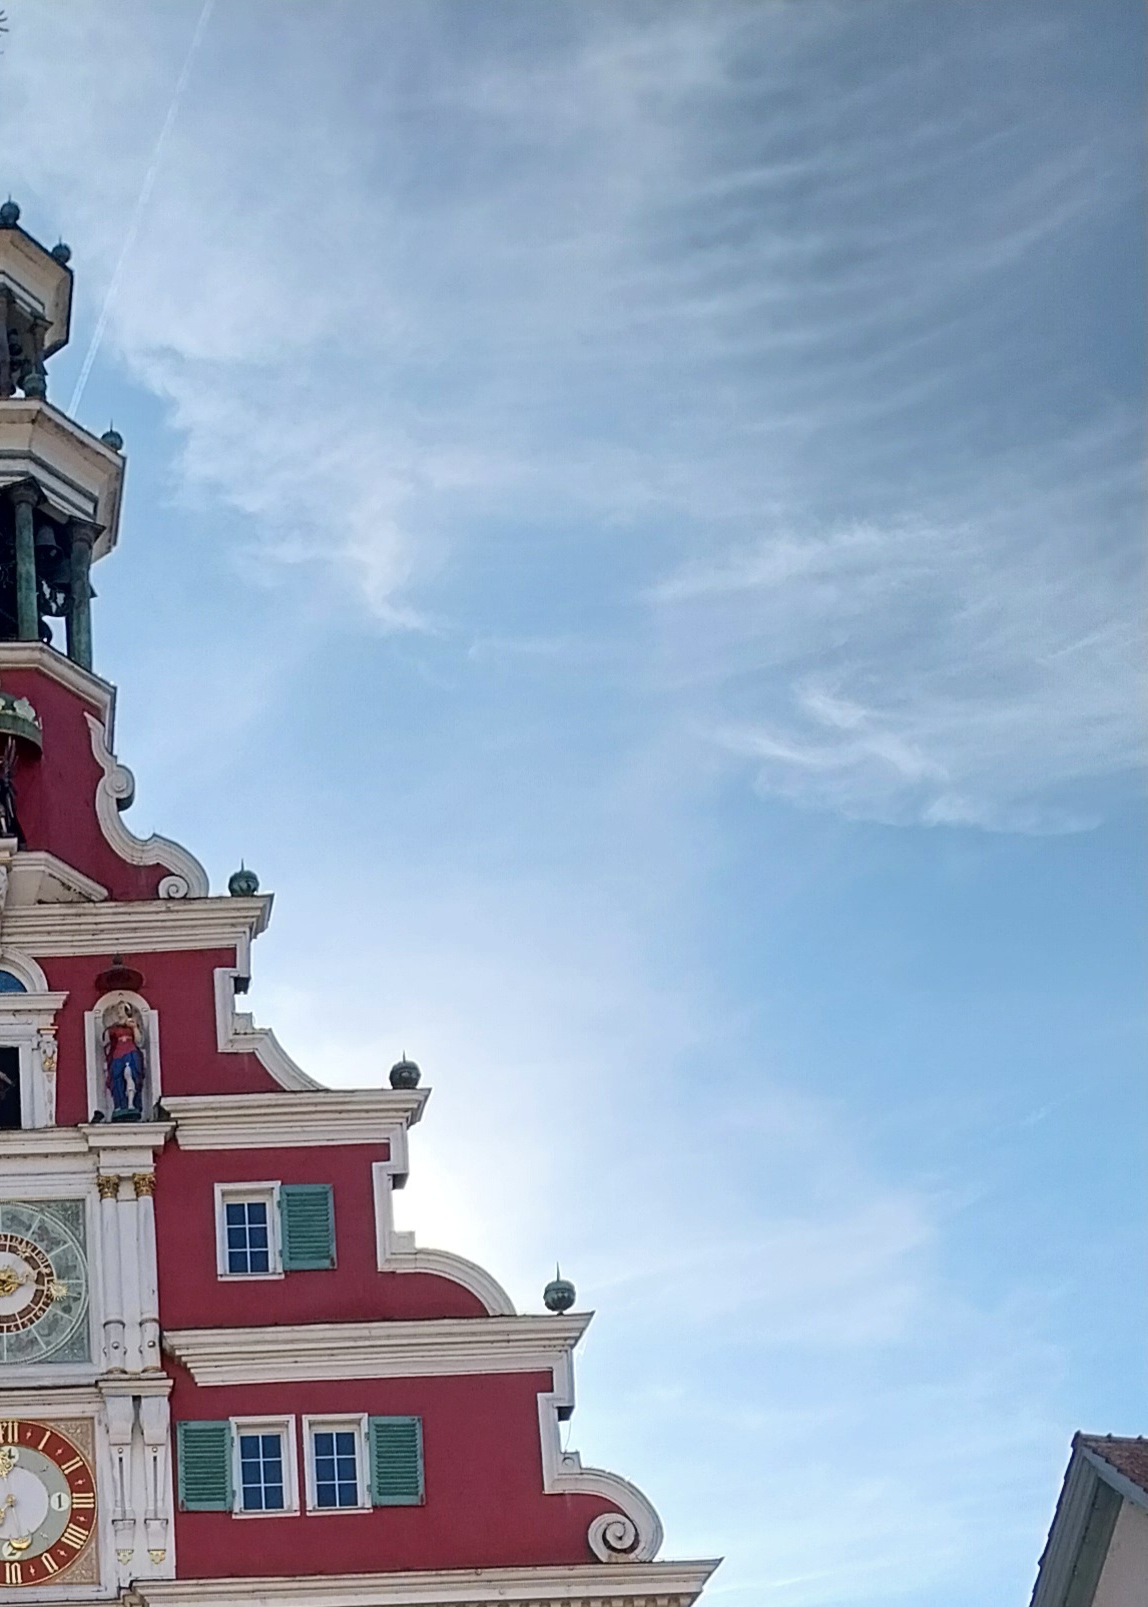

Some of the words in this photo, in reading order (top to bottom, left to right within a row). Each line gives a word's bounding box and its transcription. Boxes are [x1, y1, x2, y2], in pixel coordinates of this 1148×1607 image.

[37, 1430, 52, 1451] I
[60, 1456, 84, 1475] II
[57, 1493, 63, 1510] 1
[72, 1492, 95, 1509] III
